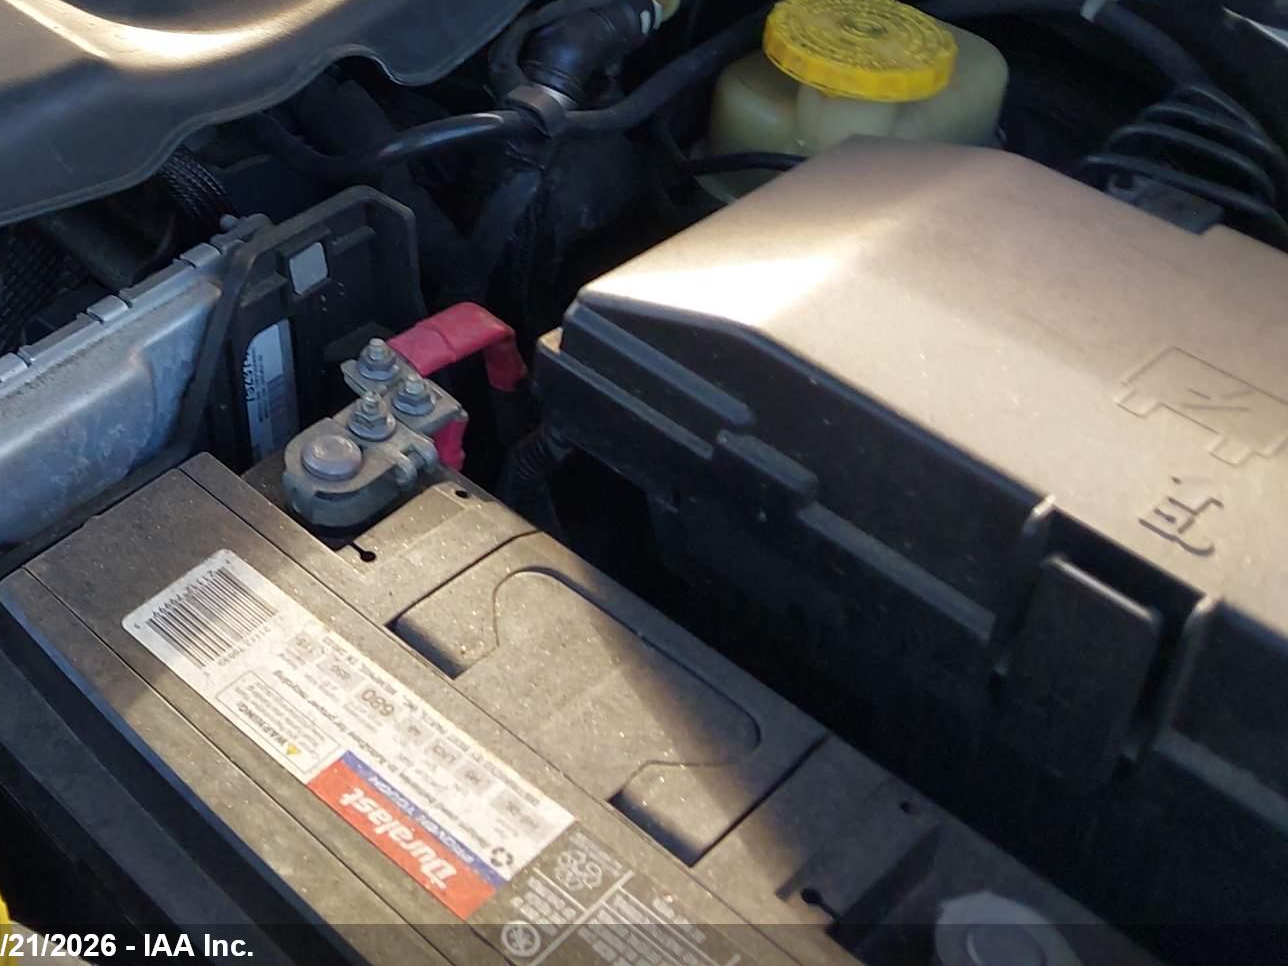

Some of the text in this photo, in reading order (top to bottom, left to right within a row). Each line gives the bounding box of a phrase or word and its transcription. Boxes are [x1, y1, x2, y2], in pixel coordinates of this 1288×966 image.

[357, 686, 398, 718] 680
[366, 773, 418, 816] TOUGH
[335, 783, 463, 892] Duralast
[414, 812, 477, 864] PROVEN
